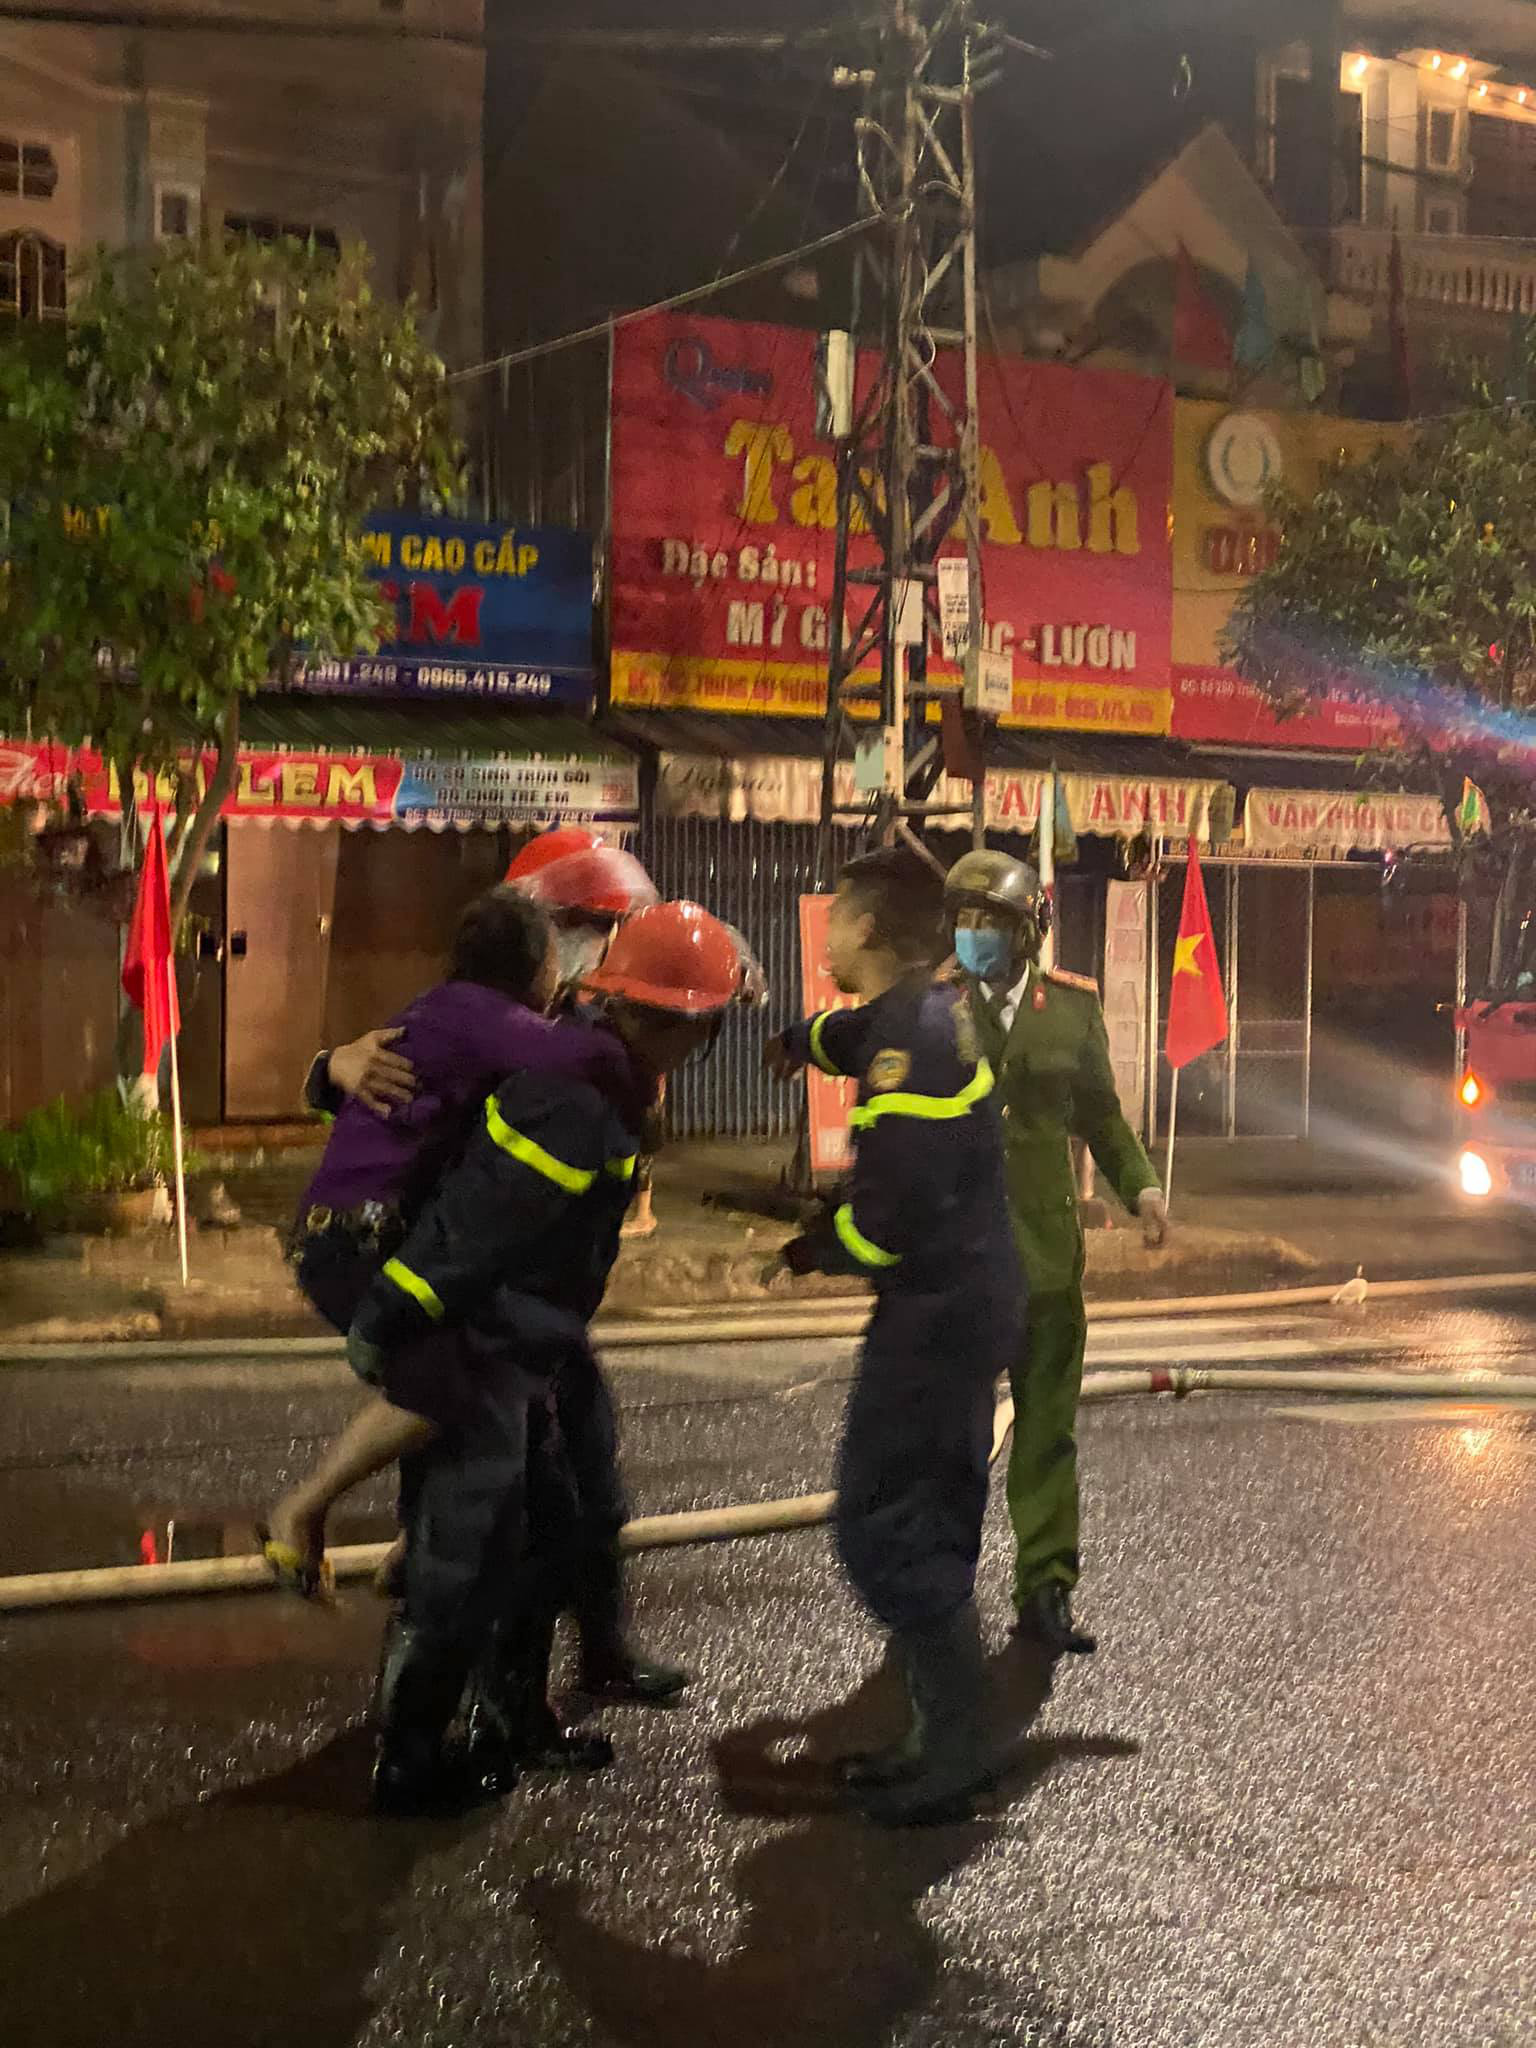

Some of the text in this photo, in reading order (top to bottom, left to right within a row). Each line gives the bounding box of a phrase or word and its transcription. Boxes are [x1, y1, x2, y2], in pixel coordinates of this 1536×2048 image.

[401, 534, 465, 573] CAO
[473, 528, 539, 577] CẤP
[1042, 622, 1137, 672] LƯƠN
[236, 761, 378, 808] LEM
[1089, 783, 1186, 824] ANH
